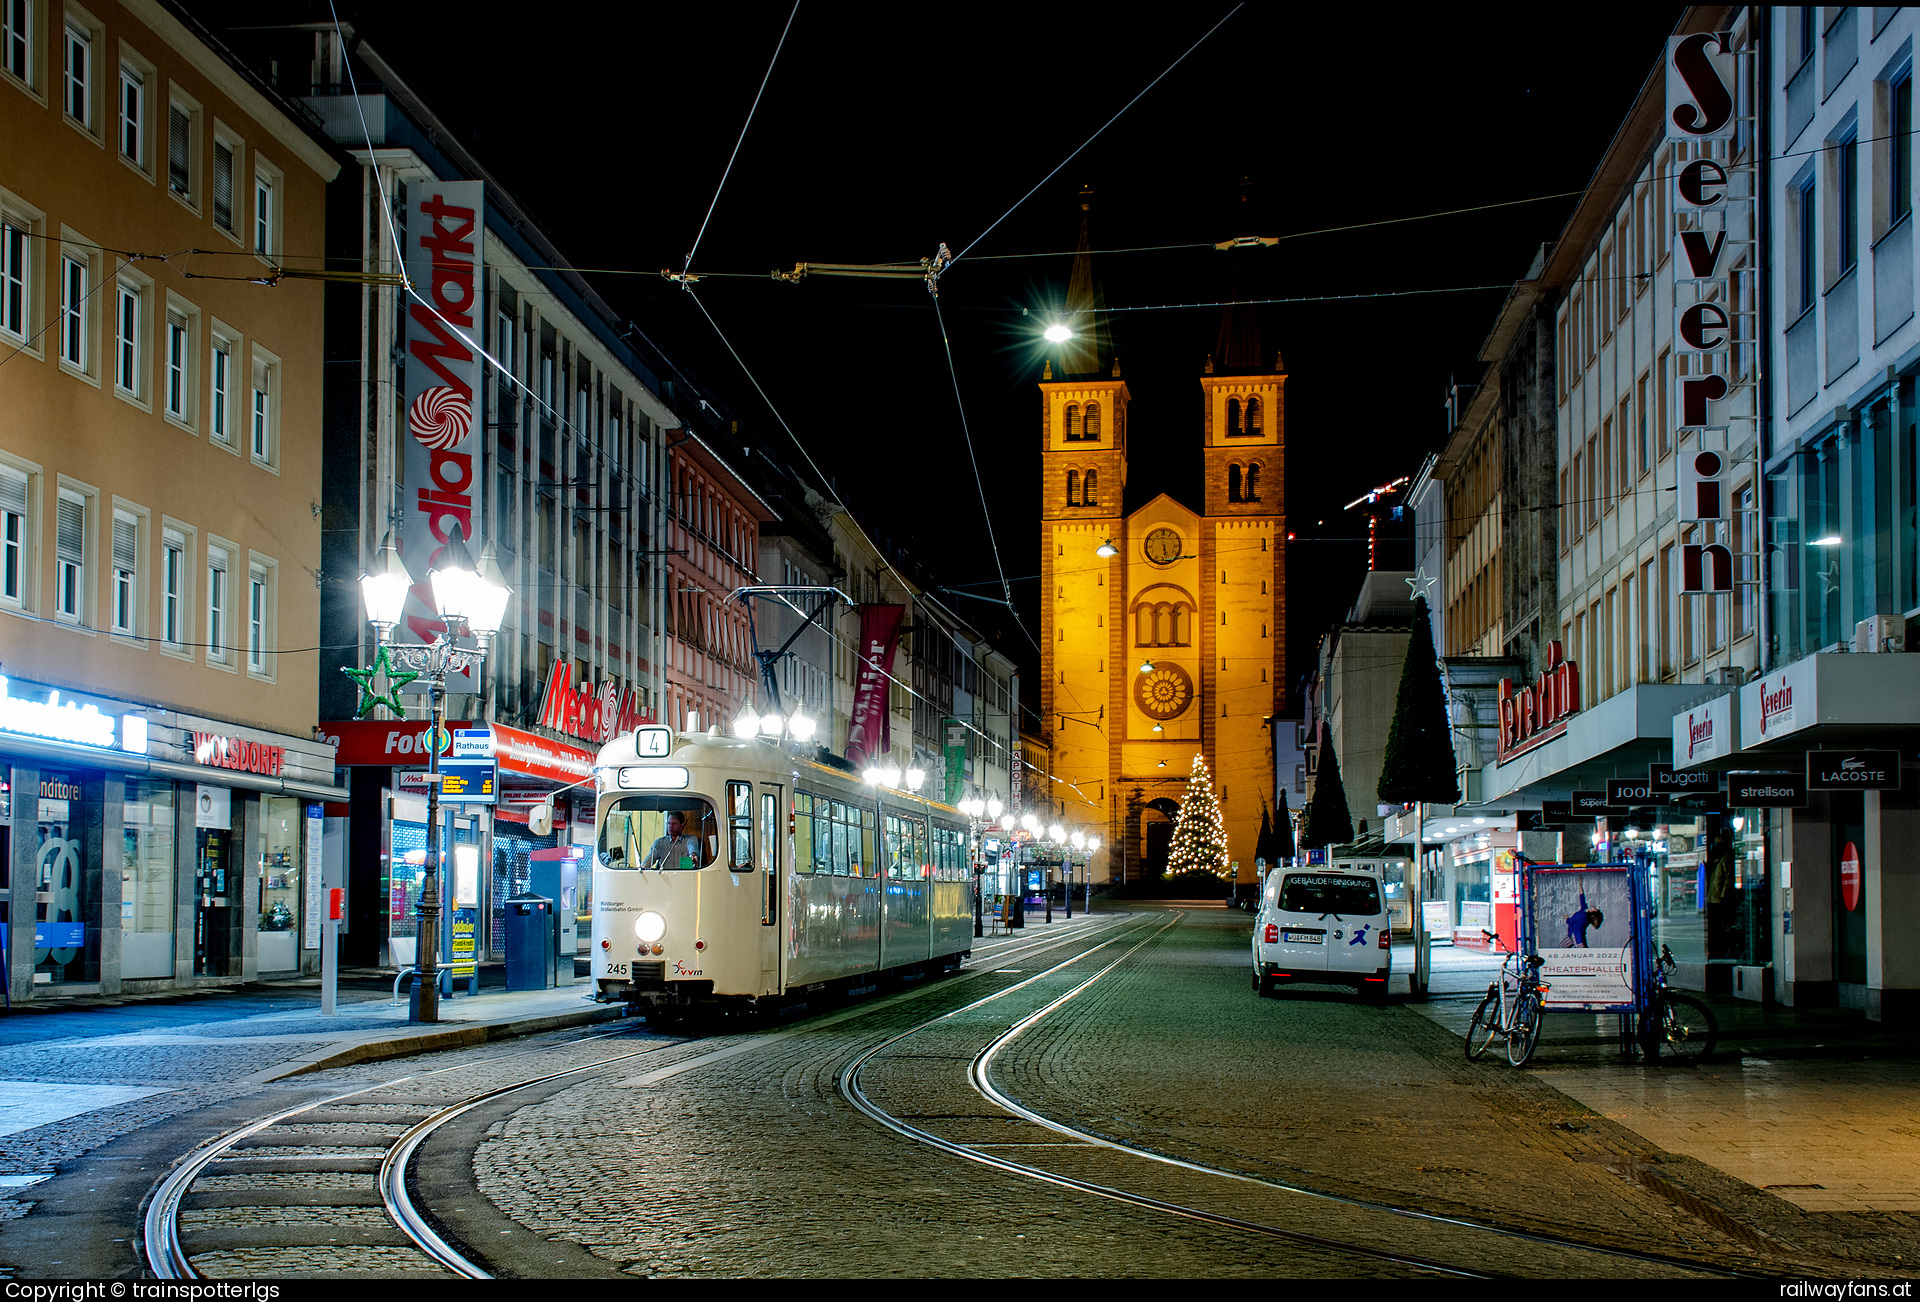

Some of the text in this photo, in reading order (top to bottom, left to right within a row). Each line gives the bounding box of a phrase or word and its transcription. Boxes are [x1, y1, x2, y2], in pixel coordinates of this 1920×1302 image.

[410, 194, 475, 402] Markt
[1672, 32, 1735, 591] Severin
[1497, 641, 1580, 765] Severin
[1760, 675, 1793, 735] Severin
[385, 731, 431, 754] Fot
[649, 732, 659, 753] 4
[1688, 709, 1713, 760] Severin
[192, 731, 286, 776] WOLSDORFF
[455, 742, 489, 750] Rathaus
[1011, 750, 1021, 822] APOTHE
[1660, 771, 1709, 786] bugatti
[1821, 771, 1886, 782] LACOSTE
[1740, 786, 1795, 798] strellson
[1291, 877, 1371, 888] GEBÄUDEREINIGUNG
[607, 963, 628, 975] 245
[1543, 965, 1621, 973] THEATERHALLE
